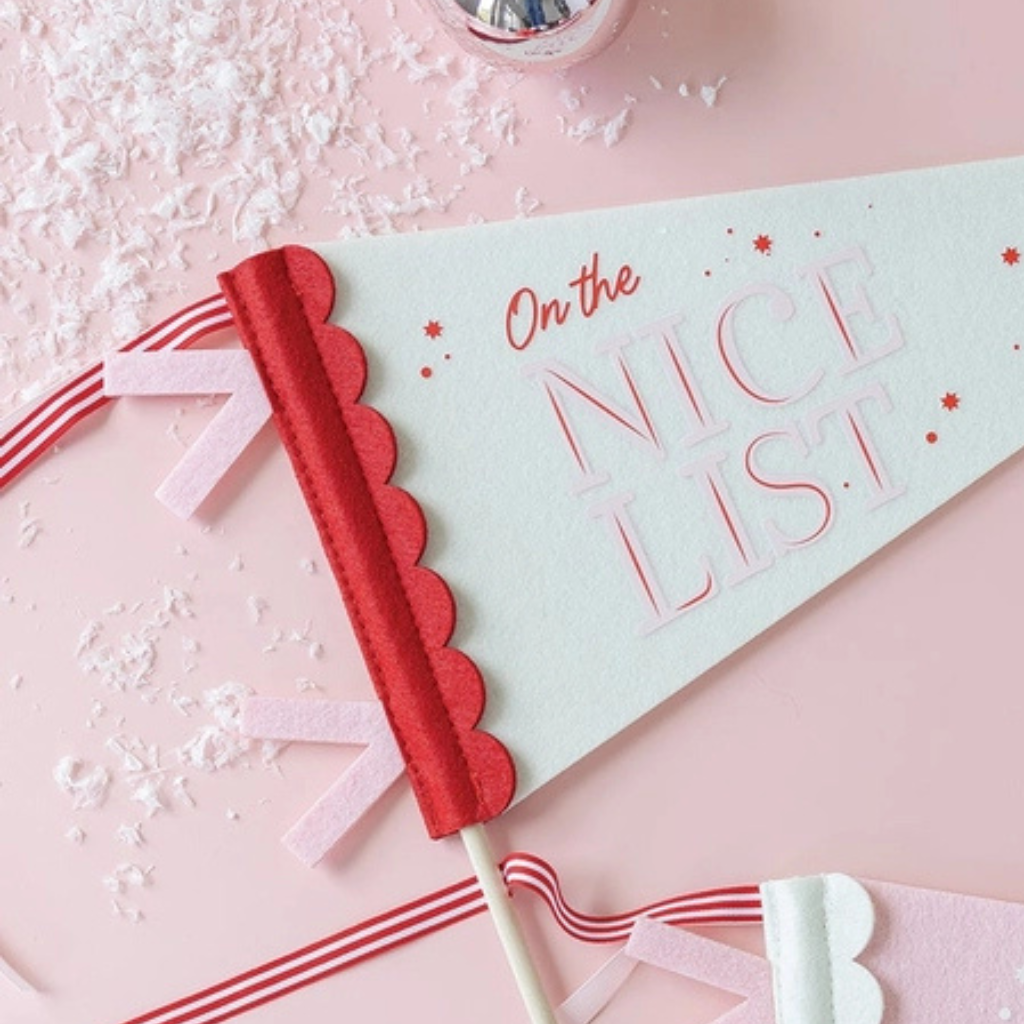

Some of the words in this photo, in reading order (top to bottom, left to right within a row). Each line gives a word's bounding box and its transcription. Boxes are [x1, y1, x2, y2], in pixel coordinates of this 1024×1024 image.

[506, 287, 570, 350] On
[569, 252, 641, 318] the
[520, 245, 906, 496] NICE
[588, 382, 908, 638] LIST
